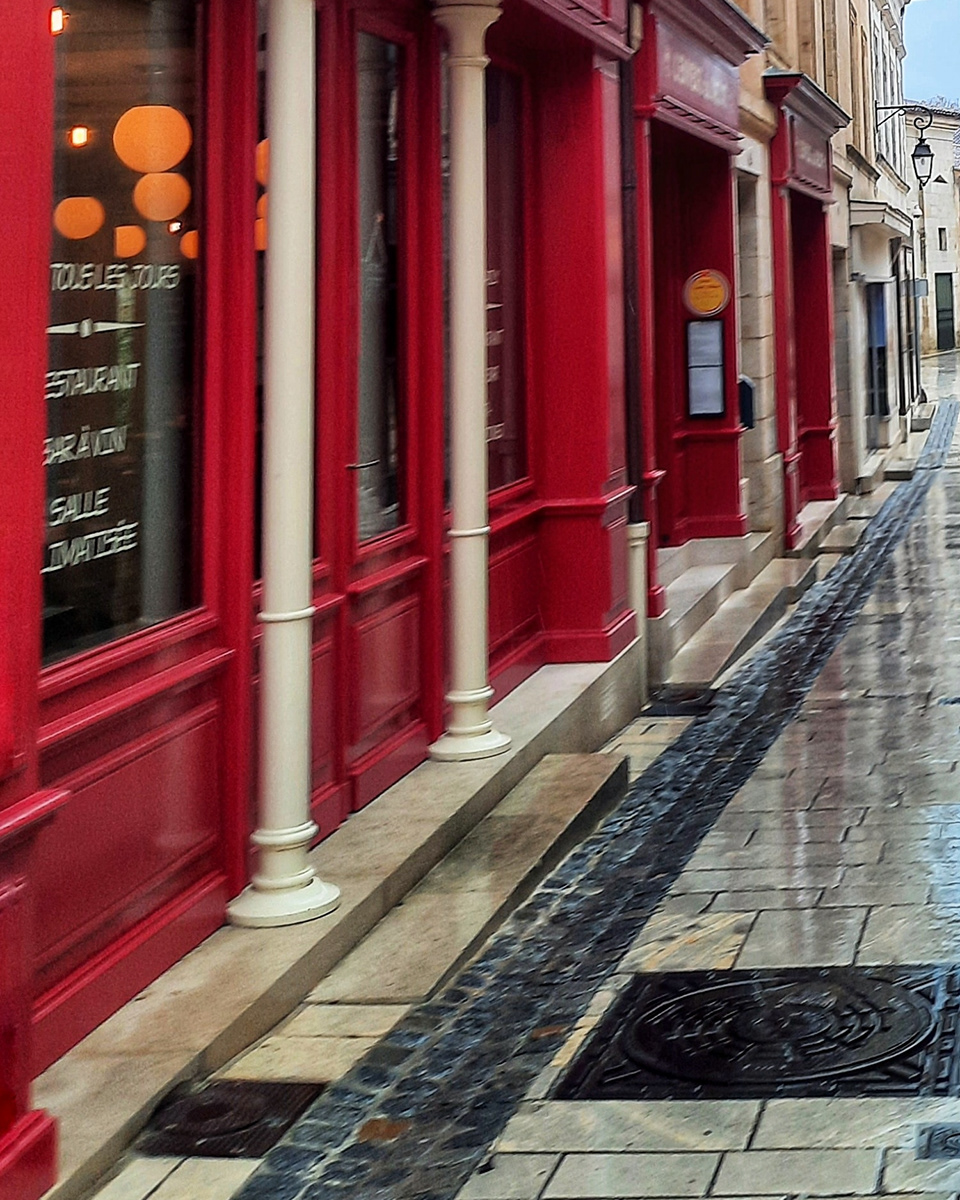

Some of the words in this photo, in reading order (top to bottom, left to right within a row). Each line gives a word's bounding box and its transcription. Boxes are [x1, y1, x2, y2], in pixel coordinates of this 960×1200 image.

[94, 263, 128, 290] LES
[43, 362, 141, 400] ESTAURANT
[48, 486, 111, 527] SALLE
